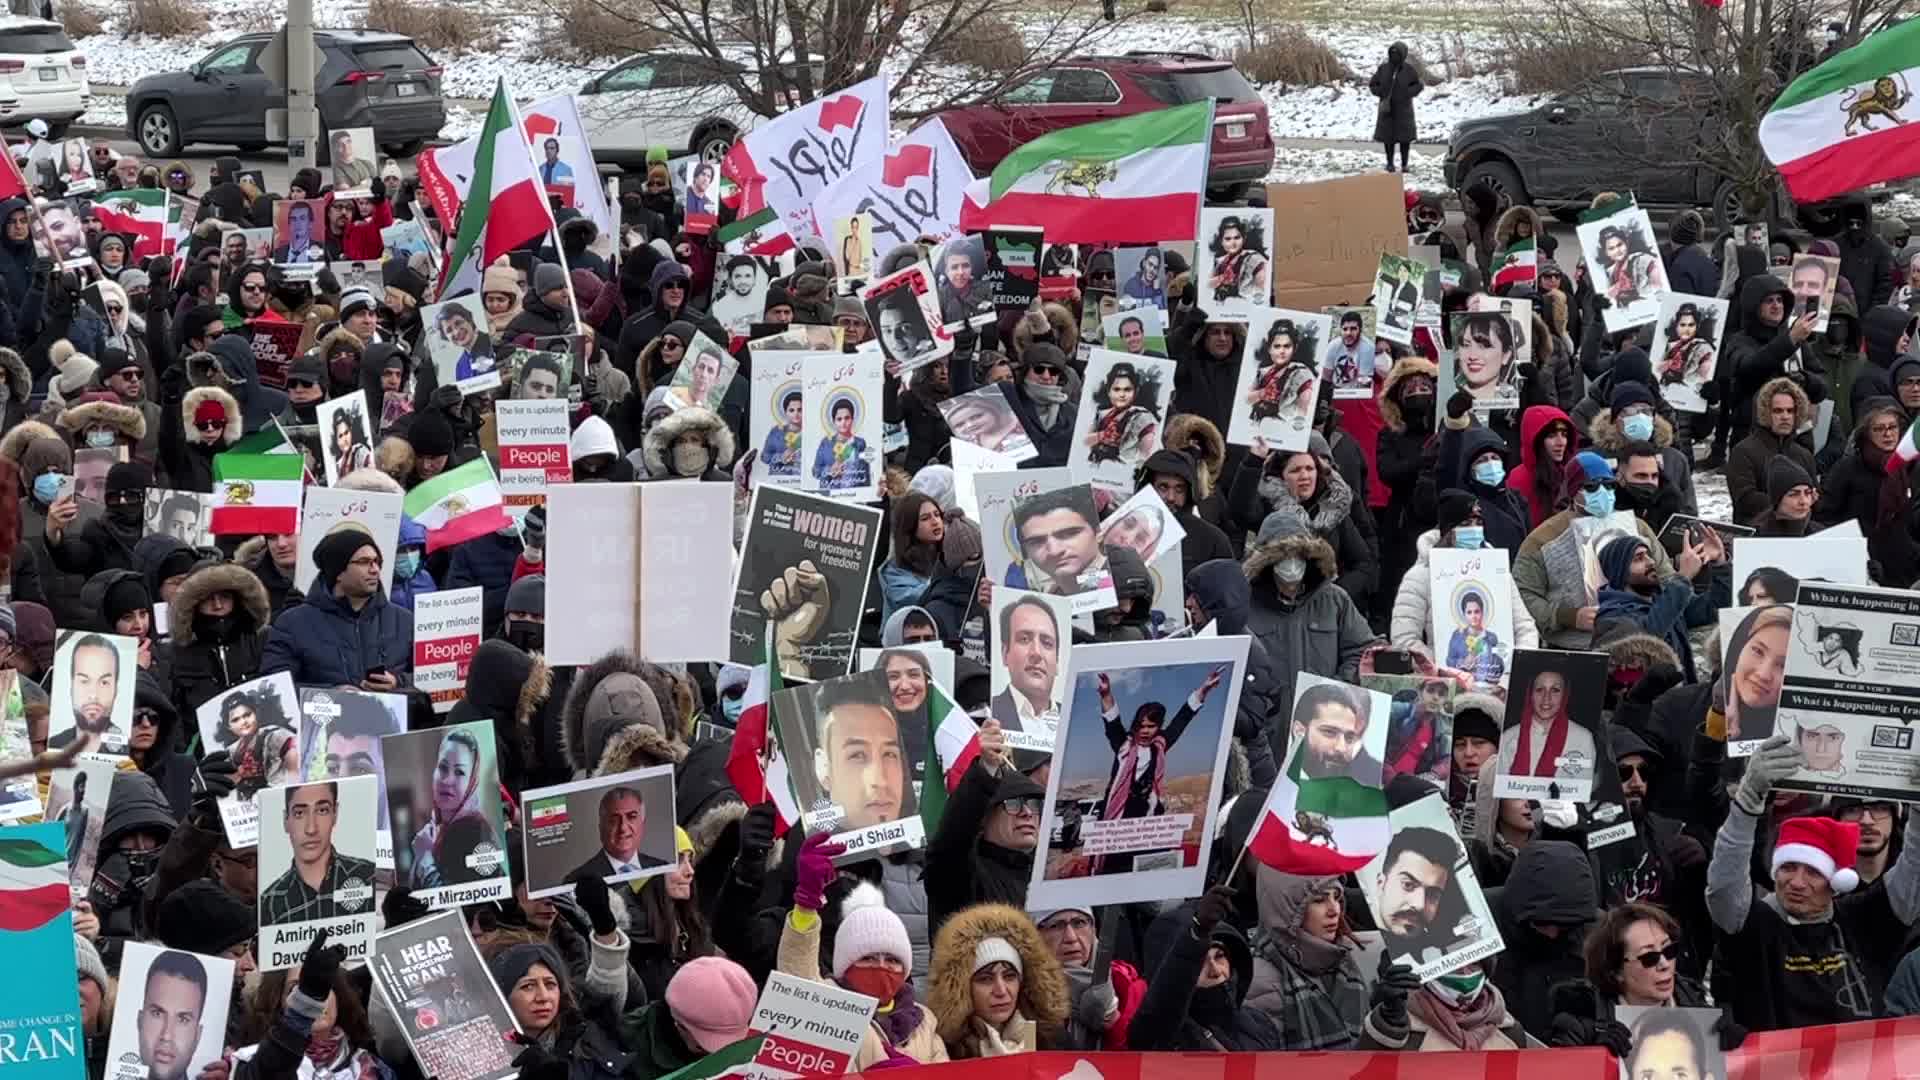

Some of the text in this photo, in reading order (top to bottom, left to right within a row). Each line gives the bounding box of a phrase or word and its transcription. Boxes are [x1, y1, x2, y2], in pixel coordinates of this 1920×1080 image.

[990, 281, 1004, 291] FE
[993, 294, 1030, 304] EEDOM
[250, 342, 278, 353] OUR
[254, 351, 287, 361] OICE
[500, 406, 513, 414] The
[514, 406, 524, 414] list
[533, 405, 565, 415] updated
[500, 426, 566, 438] every minute
[509, 447, 561, 466] People
[518, 473, 545, 485] being
[803, 536, 863, 560] for women's
[820, 552, 860, 570] freedom
[417, 601, 431, 609] The
[432, 599, 442, 607] list
[450, 594, 480, 606] updated
[1810, 592, 1839, 603] What
[1851, 596, 1906, 611] happening
[1908, 602, 1919, 610] in
[417, 616, 480, 632] every minute
[424, 639, 473, 660] People
[416, 673, 429, 681] are
[431, 669, 456, 681] being
[1792, 695, 1920, 716] What is happening in Ira
[1507, 780, 1546, 793] Maryam
[866, 823, 905, 845] Shiazi
[438, 884, 503, 905] Mirzapour
[400, 935, 453, 966] HEAR
[402, 963, 447, 990] IRAN
[771, 980, 871, 1017] The list is updated
[19, 1014, 61, 1028] CHANGE
[759, 1008, 860, 1044] every minute
[0, 1025, 77, 1065] RAN
[758, 1036, 836, 1075] People
